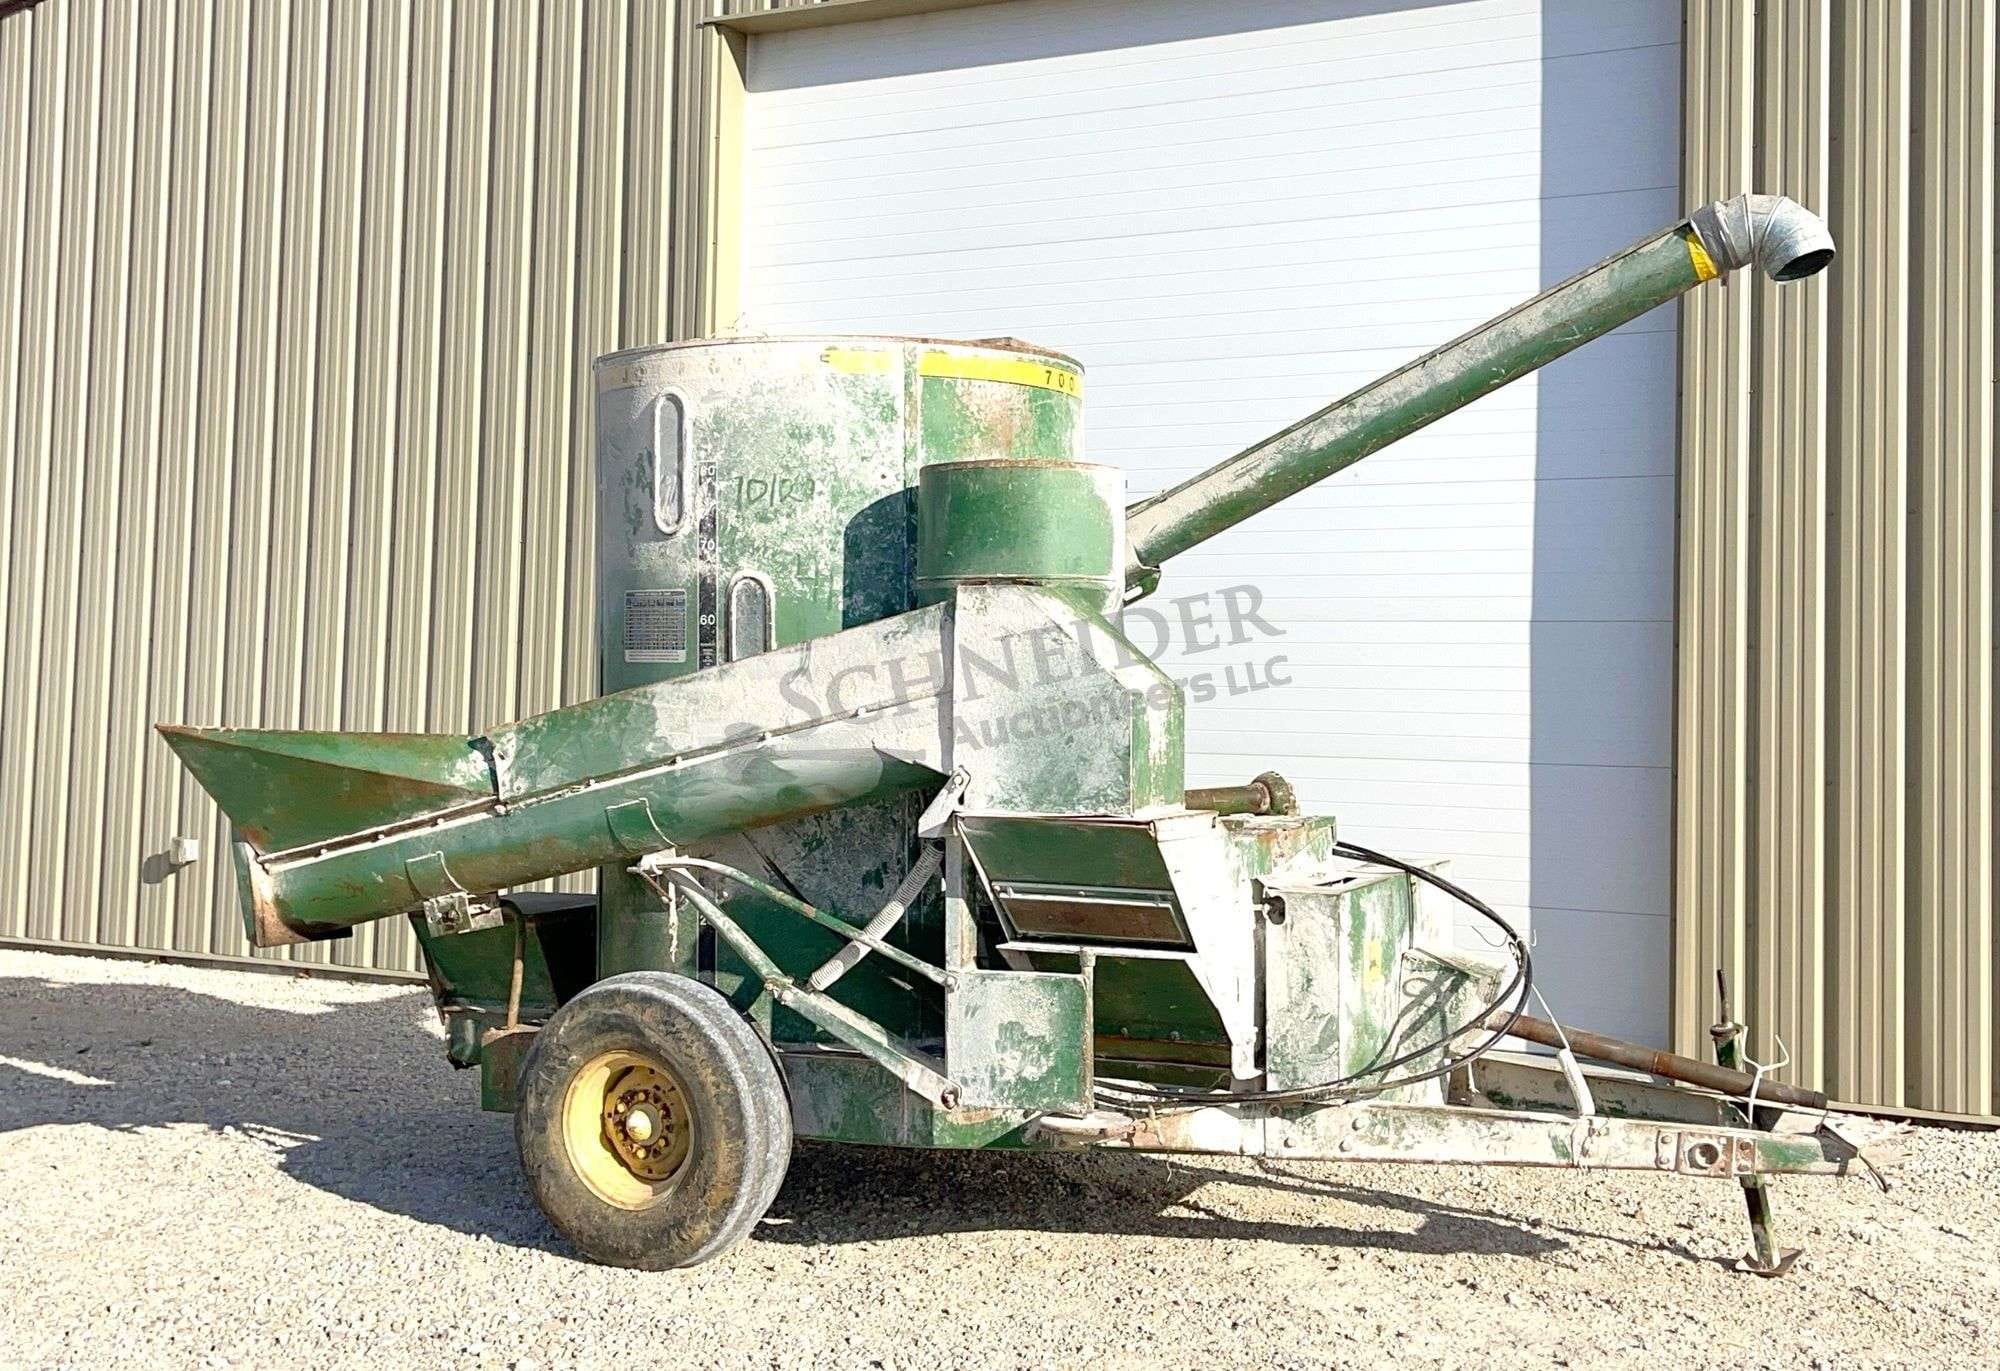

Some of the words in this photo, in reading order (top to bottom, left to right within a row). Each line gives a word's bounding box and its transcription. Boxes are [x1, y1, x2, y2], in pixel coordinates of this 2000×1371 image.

[1045, 370, 1074, 392] 700
[700, 540, 715, 551] 70
[700, 614, 716, 625] 60
